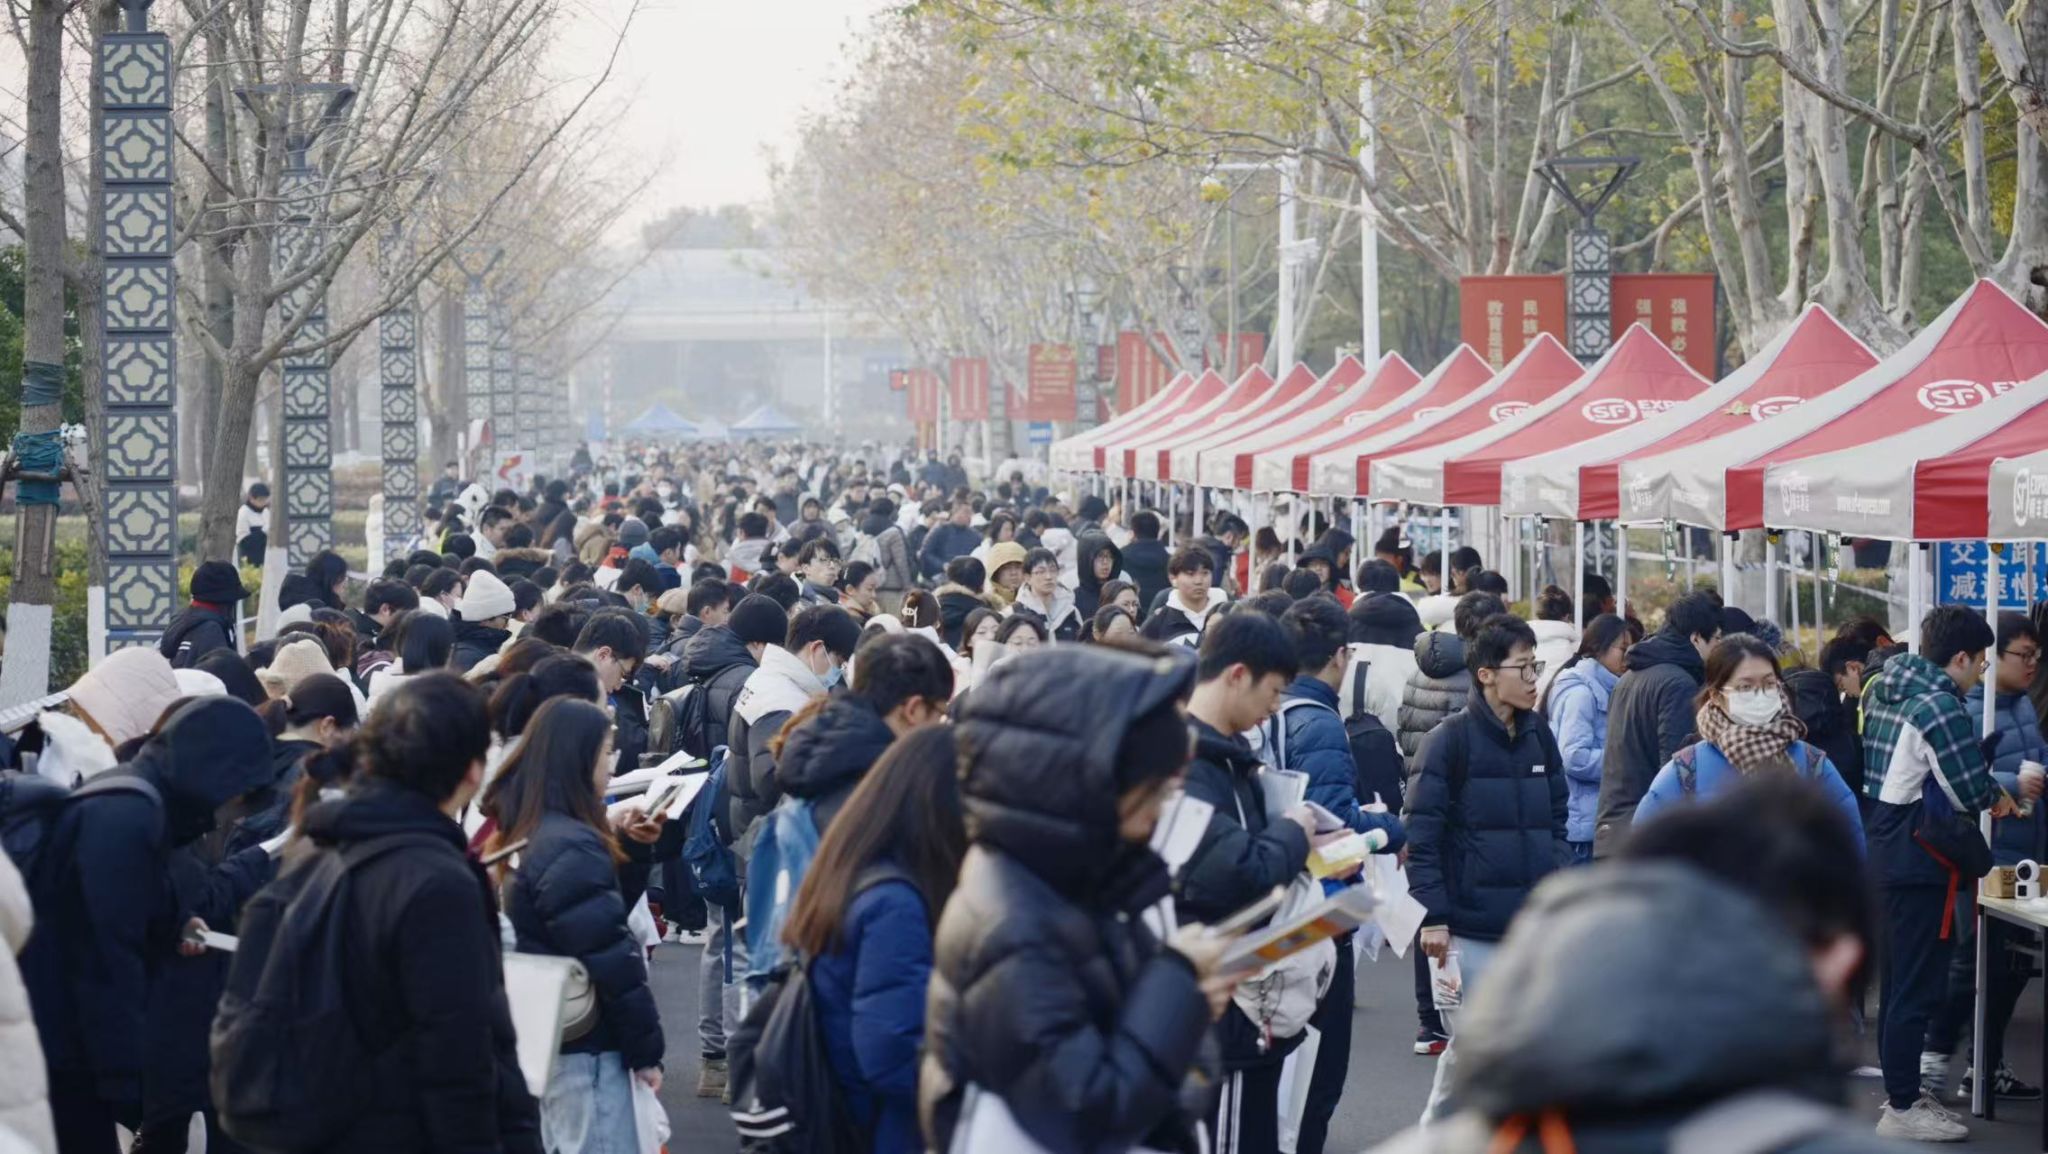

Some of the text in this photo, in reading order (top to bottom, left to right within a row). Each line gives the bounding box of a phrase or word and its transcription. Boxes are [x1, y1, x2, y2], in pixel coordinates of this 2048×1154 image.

[1671, 297, 1687, 362] 强教必
[1950, 540, 2048, 566] 交路
[1950, 571, 2048, 600] 减速慢
